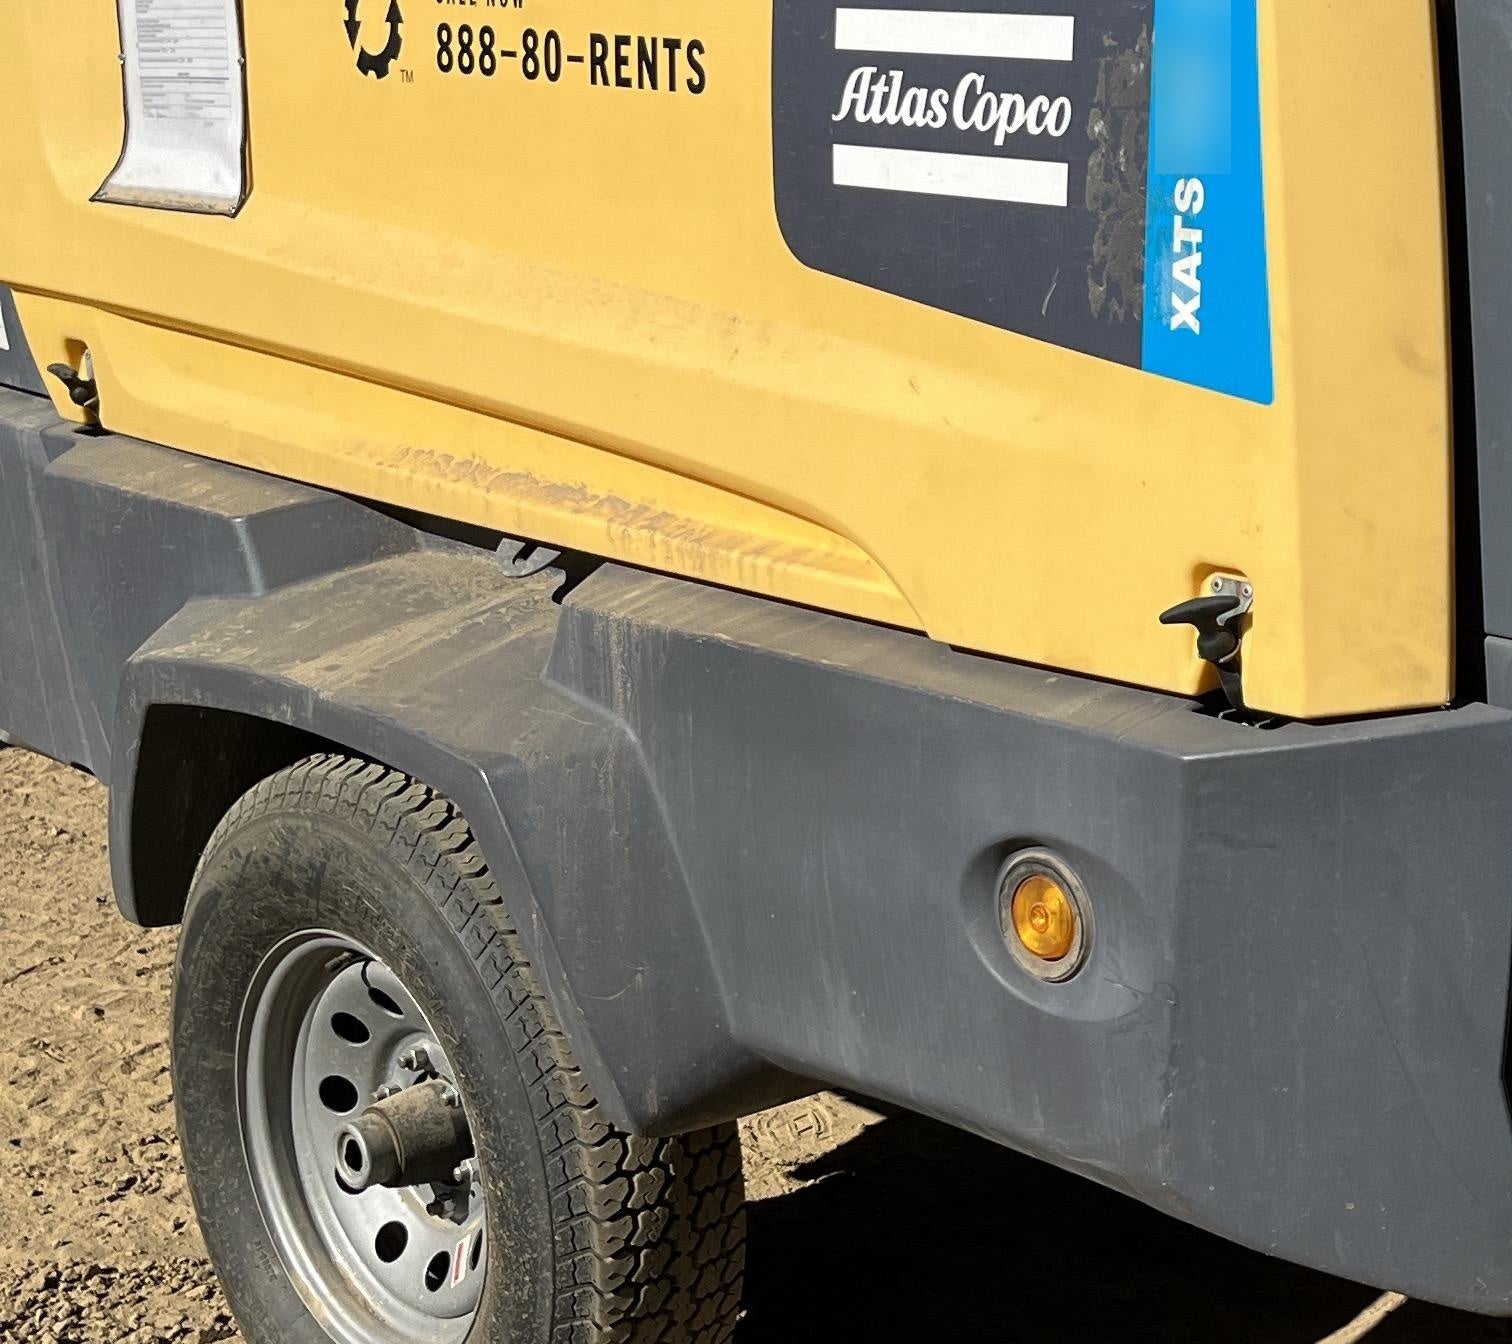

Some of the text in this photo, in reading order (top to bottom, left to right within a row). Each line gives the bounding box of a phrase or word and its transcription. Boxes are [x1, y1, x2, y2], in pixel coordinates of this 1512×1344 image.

[436, 22, 706, 95] 888-80-RENTS
[831, 65, 1073, 146] Atlas Copco
[1170, 177, 1206, 335] XATS
